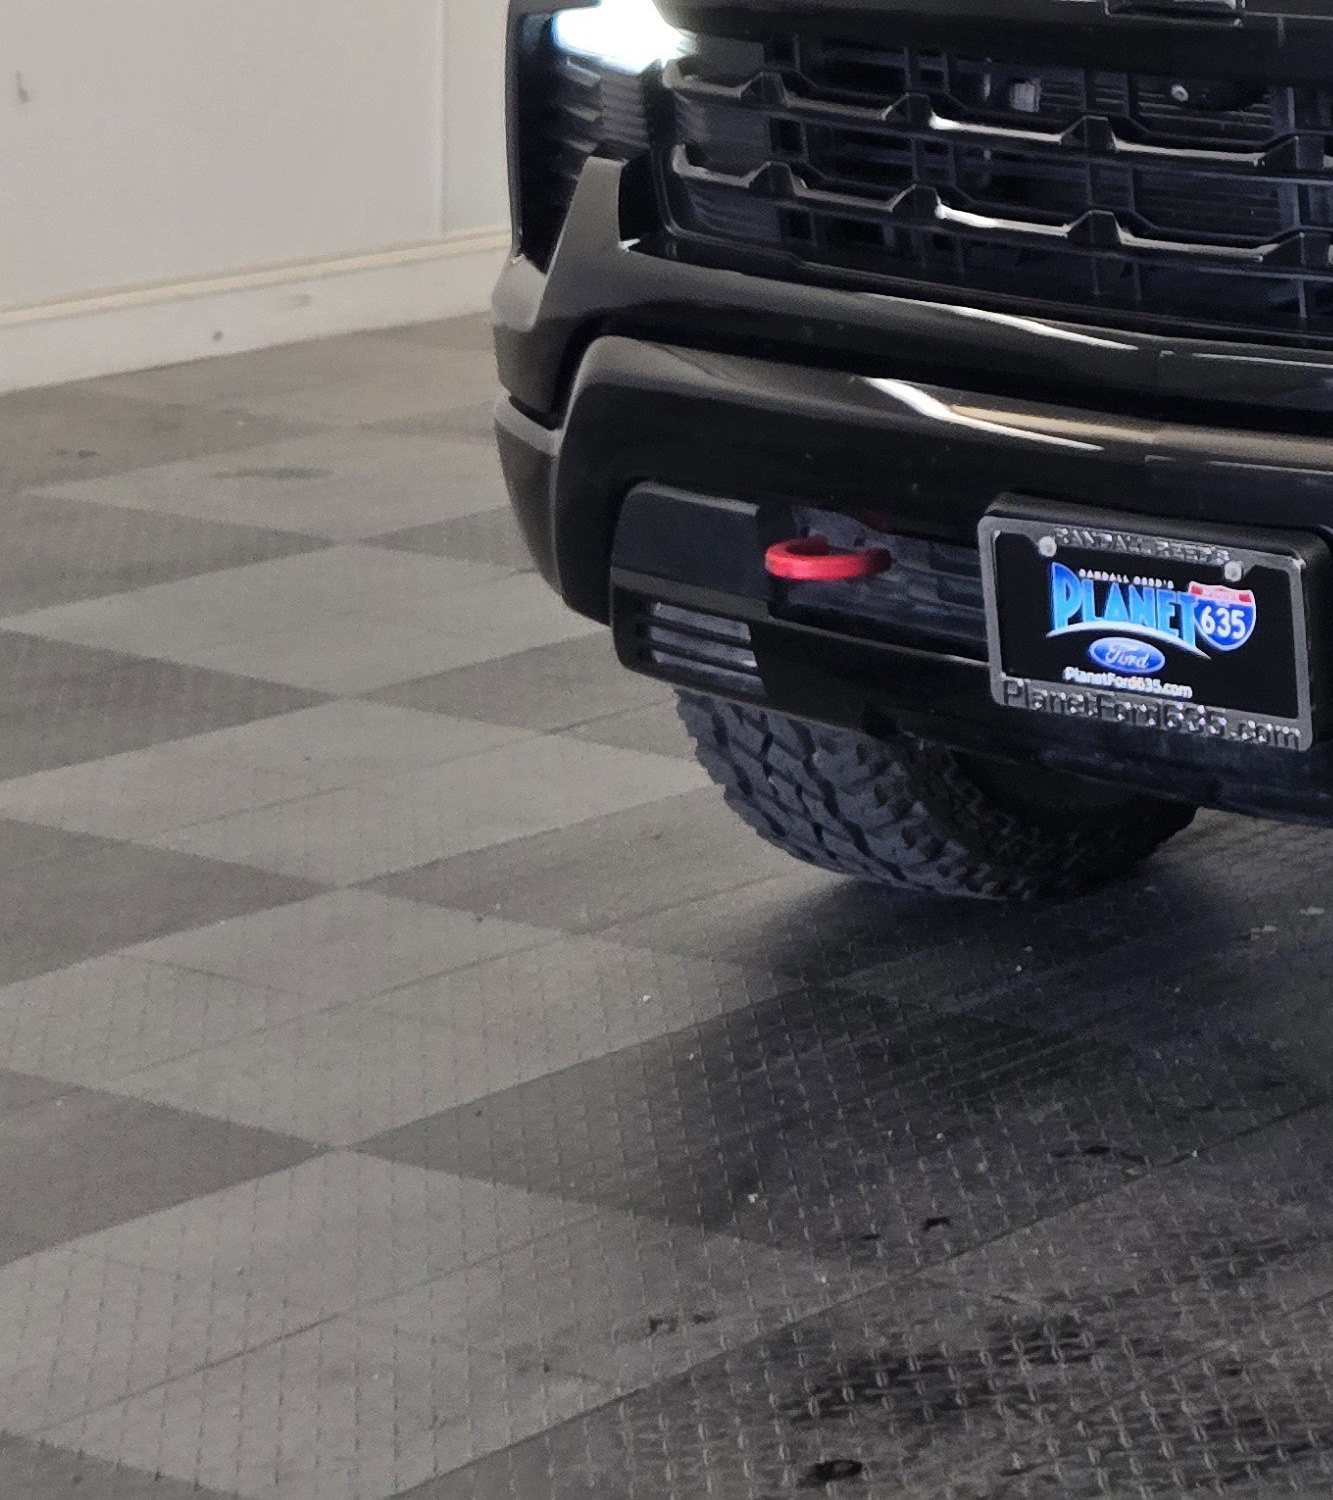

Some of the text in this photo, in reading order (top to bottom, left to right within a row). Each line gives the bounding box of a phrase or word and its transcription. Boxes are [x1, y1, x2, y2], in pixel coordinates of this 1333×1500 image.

[1052, 562, 1246, 648] PLANET 635
[1105, 644, 1150, 669] Ford
